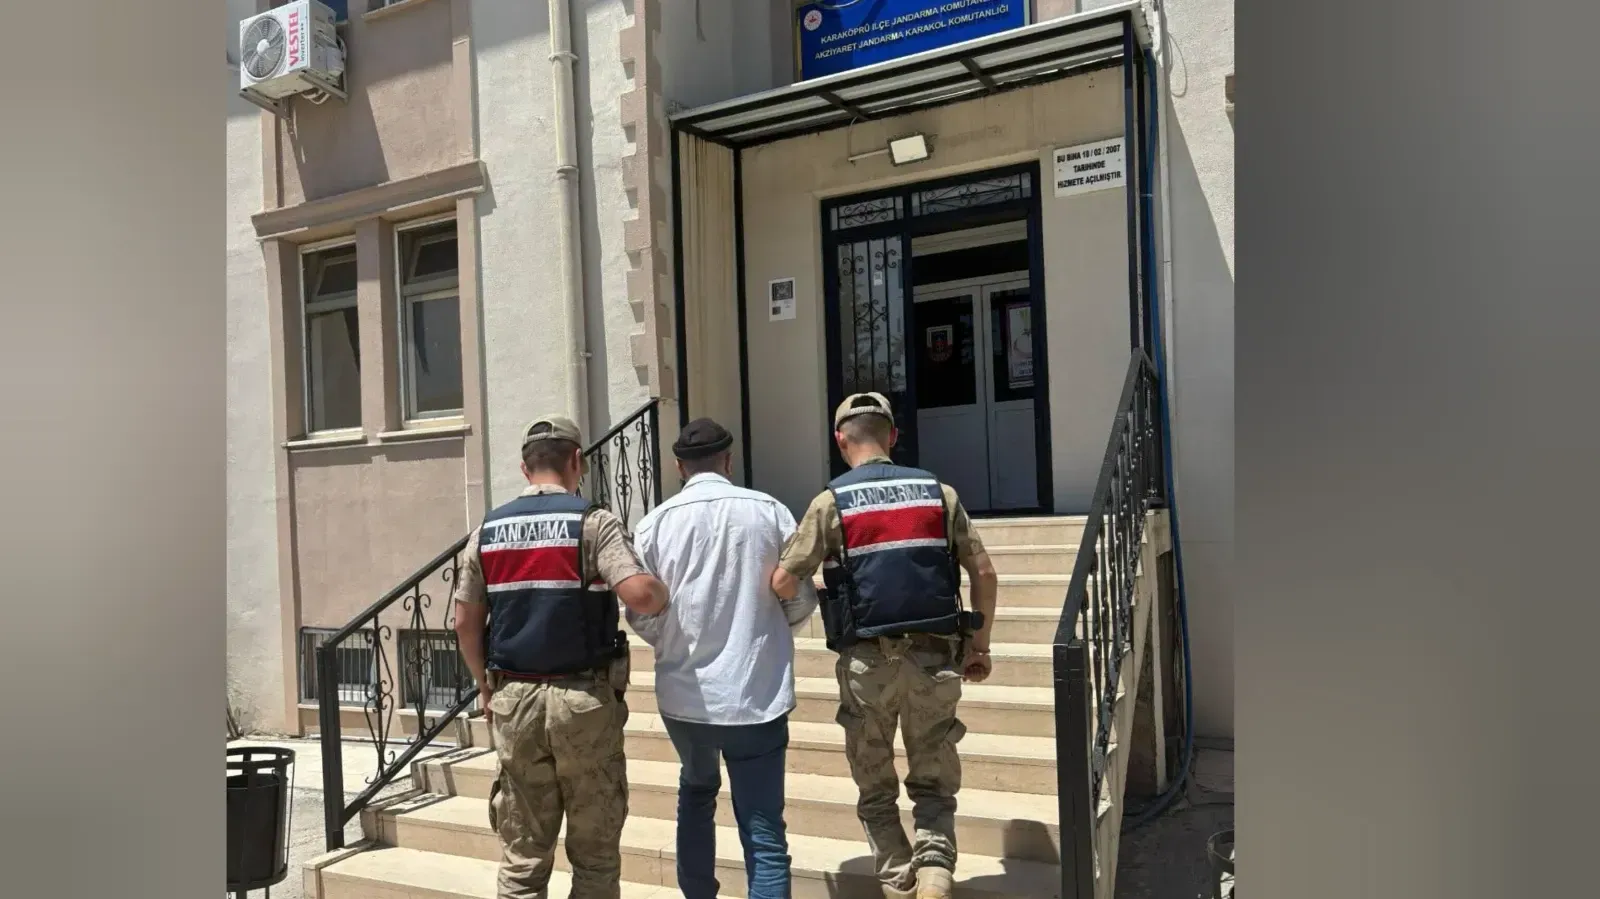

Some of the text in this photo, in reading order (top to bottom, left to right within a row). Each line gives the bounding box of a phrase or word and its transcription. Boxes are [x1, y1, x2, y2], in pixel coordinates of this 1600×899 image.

[288, 8, 299, 66] VESTEL
[820, 23, 870, 44] KARAKÖPRÜ
[892, 7, 939, 26] JANDARMA
[858, 31, 904, 48] JANDARMA
[905, 20, 947, 37] KARAKOL
[948, 4, 1009, 26] KOMUTANLIĞI
[1057, 155, 1066, 163] BU
[1094, 148, 1102, 156] 02
[848, 484, 932, 507] JANDARMA
[489, 520, 570, 543] JANDARMA
